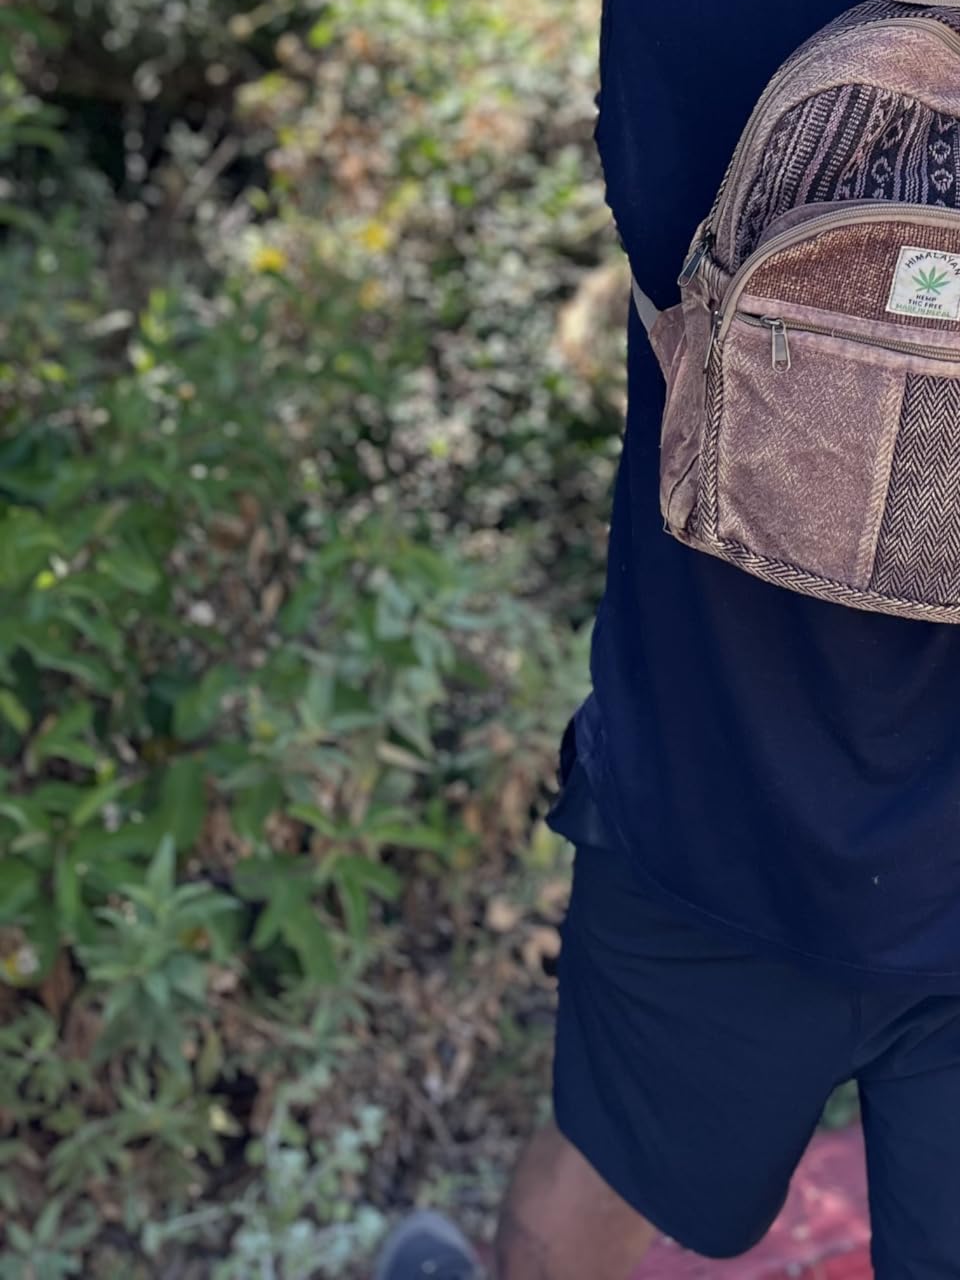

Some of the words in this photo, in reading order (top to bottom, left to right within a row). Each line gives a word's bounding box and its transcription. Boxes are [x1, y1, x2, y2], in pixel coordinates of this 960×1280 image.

[896, 303, 916, 312] MADE
[908, 299, 923, 307] THC
[924, 302, 943, 310] FREE
